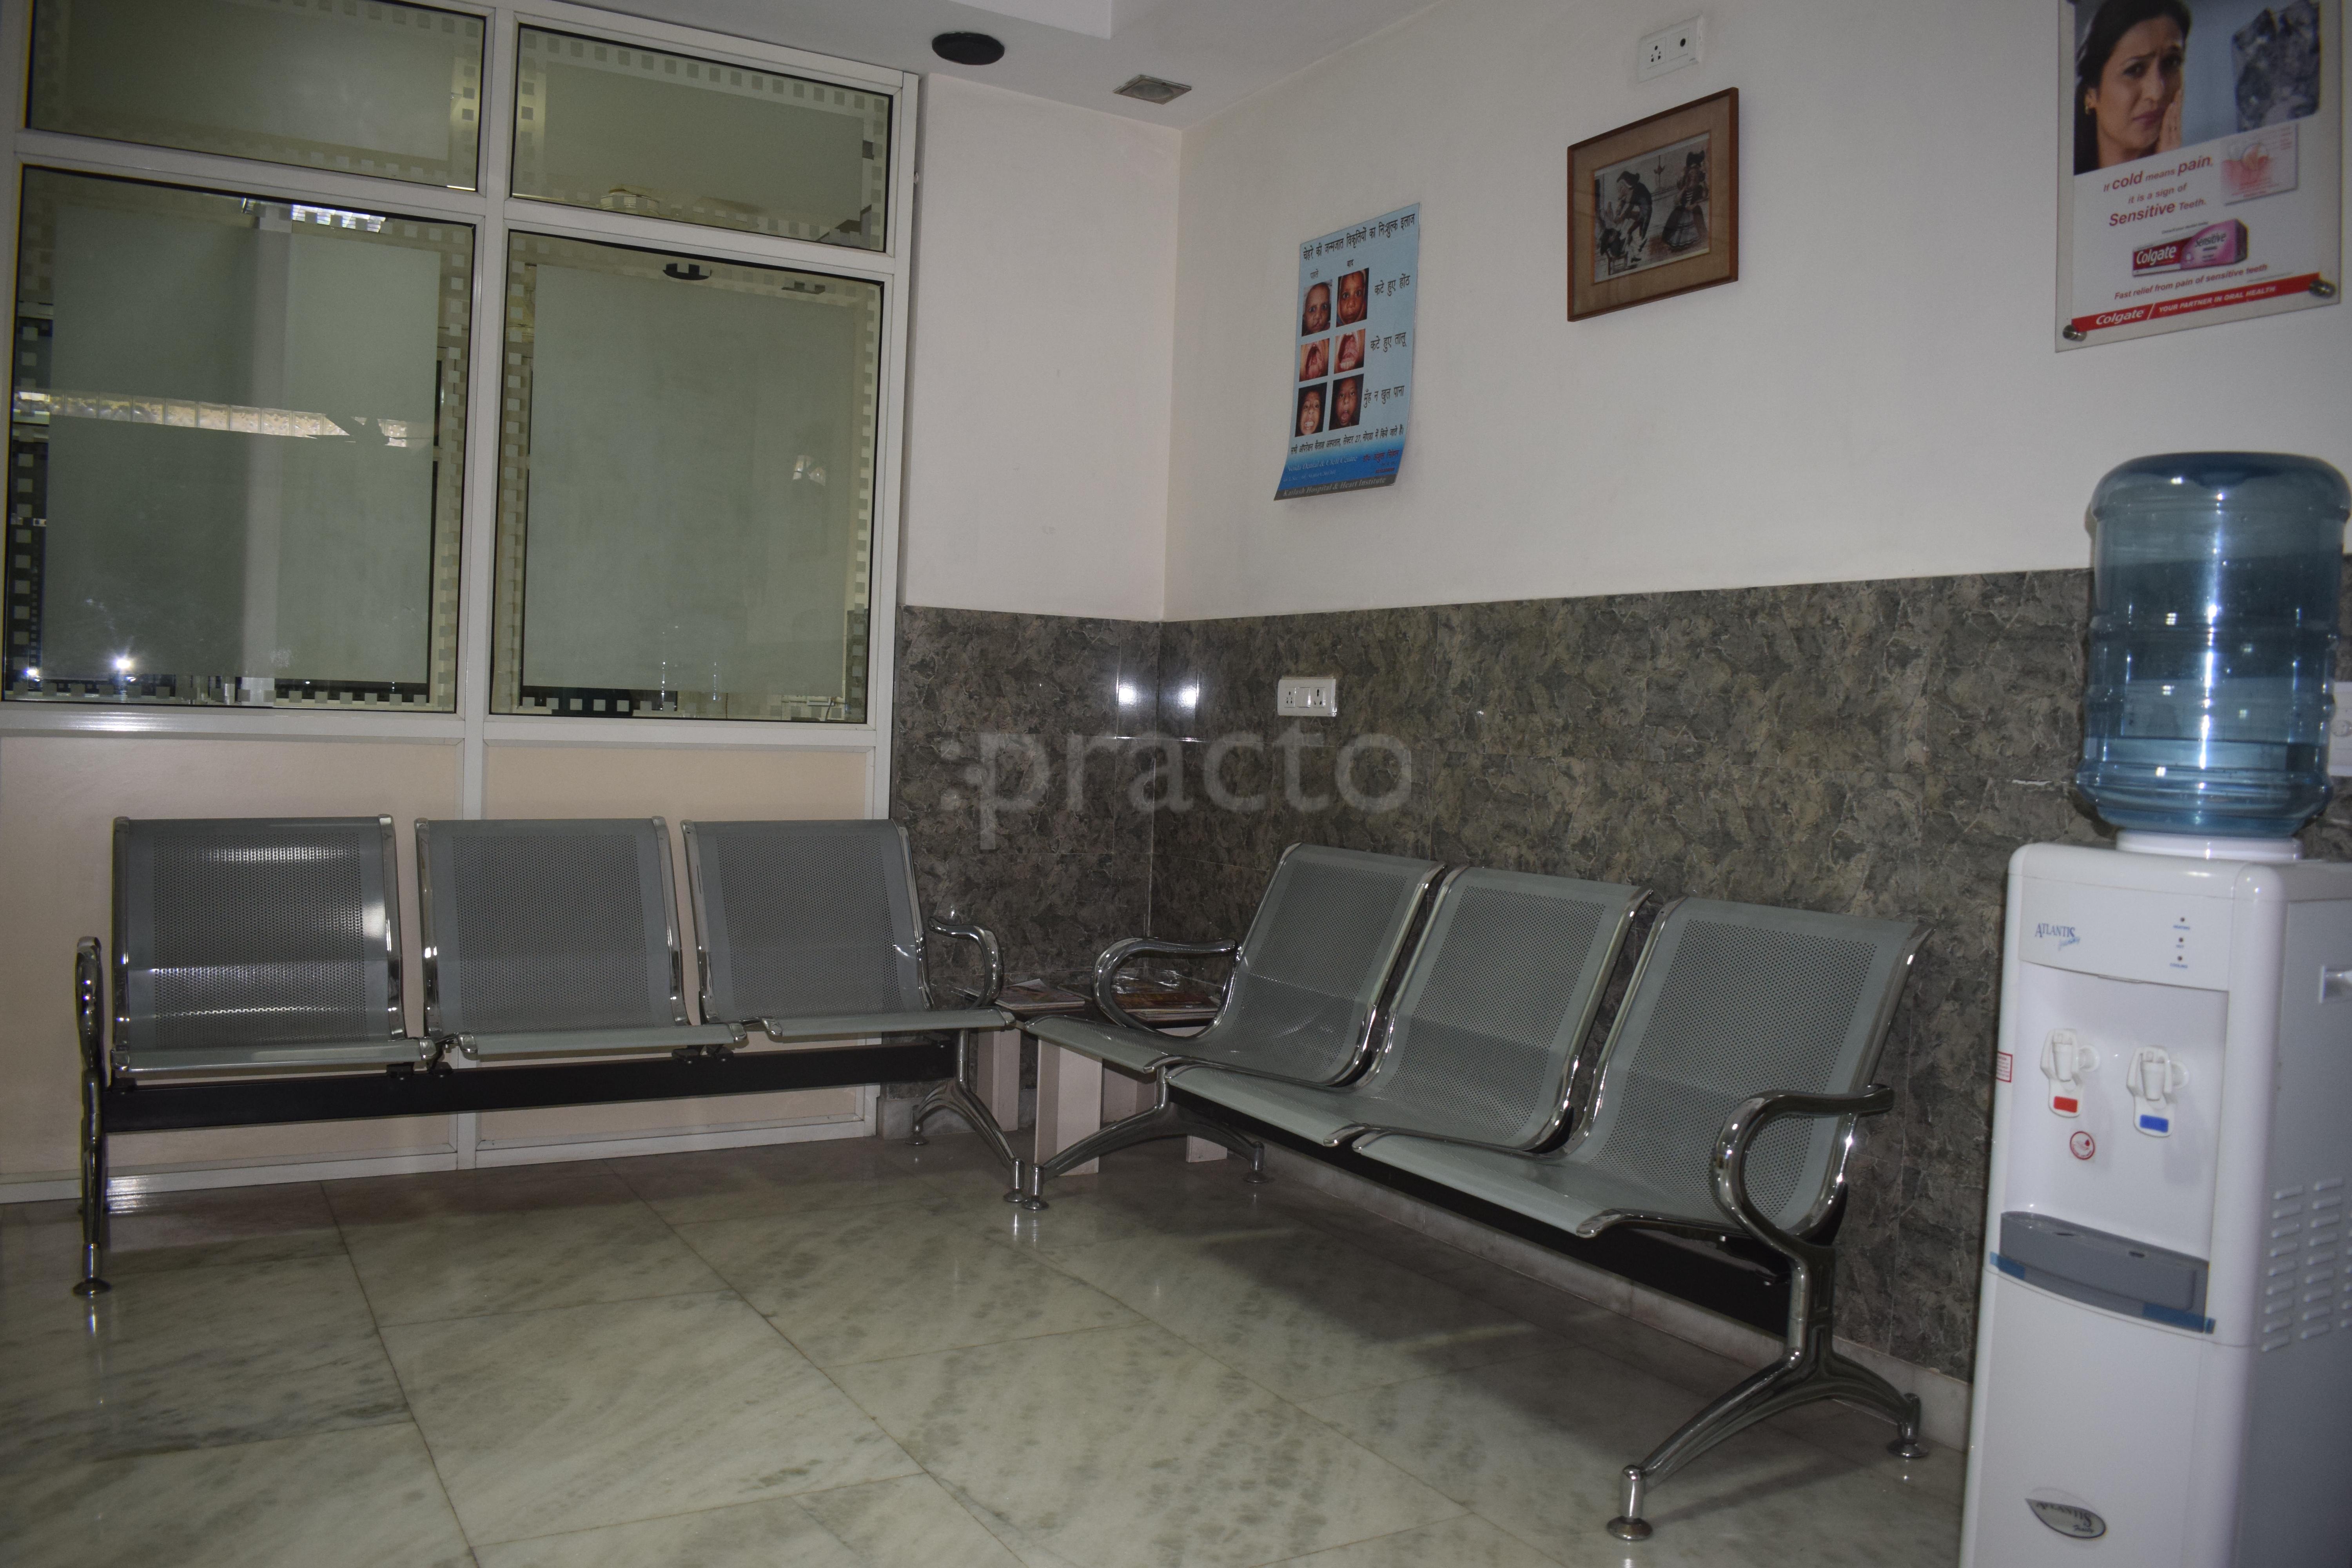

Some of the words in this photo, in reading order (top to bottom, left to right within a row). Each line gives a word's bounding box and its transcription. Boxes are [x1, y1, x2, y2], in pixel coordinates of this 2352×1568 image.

[2103, 183, 2110, 192] If
[2112, 170, 2143, 189] cold
[2145, 169, 2175, 181] means
[2128, 196, 2134, 204] it
[2156, 187, 2174, 198] sign
[2178, 182, 2187, 192] of
[2109, 203, 2176, 226] Sensitive
[1303, 245, 1314, 260] चेहरे
[1316, 242, 1322, 257] की
[1325, 238, 1344, 254] जन्मजात
[1369, 227, 1376, 239] का
[1401, 213, 1415, 230] इलाज
[2195, 232, 2227, 247] Sensitive
[2136, 246, 2176, 266] Colgate
[1374, 280, 1384, 295] कटे
[1387, 280, 1396, 296] हुए
[2114, 291, 2131, 300] Fast
[2133, 285, 2154, 296] relief
[2155, 283, 2173, 292] from
[2175, 279, 2193, 289] pain
[2205, 269, 2244, 282] sensitive
[2246, 263, 2268, 274] teeth
[2096, 309, 2144, 325] Colgate
[2159, 303, 2178, 312] YOUR
[2180, 297, 2213, 309] PARTNER
[2224, 292, 2244, 301] ORAL
[2245, 286, 2276, 296] HEALTH
[1370, 336, 1380, 351] कटे
[1383, 336, 1392, 352] हुए
[1395, 332, 1406, 347] तालू
[1374, 391, 1379, 401] न
[1381, 388, 1391, 405] खुल
[1394, 385, 1405, 397] पाना
[1283, 487, 1305, 497] Kailash
[1306, 483, 1332, 493] Hospital
[1340, 481, 1357, 489] Heart
[1359, 477, 1387, 486] Institute
[2034, 922, 2076, 938] ATLANTIS
